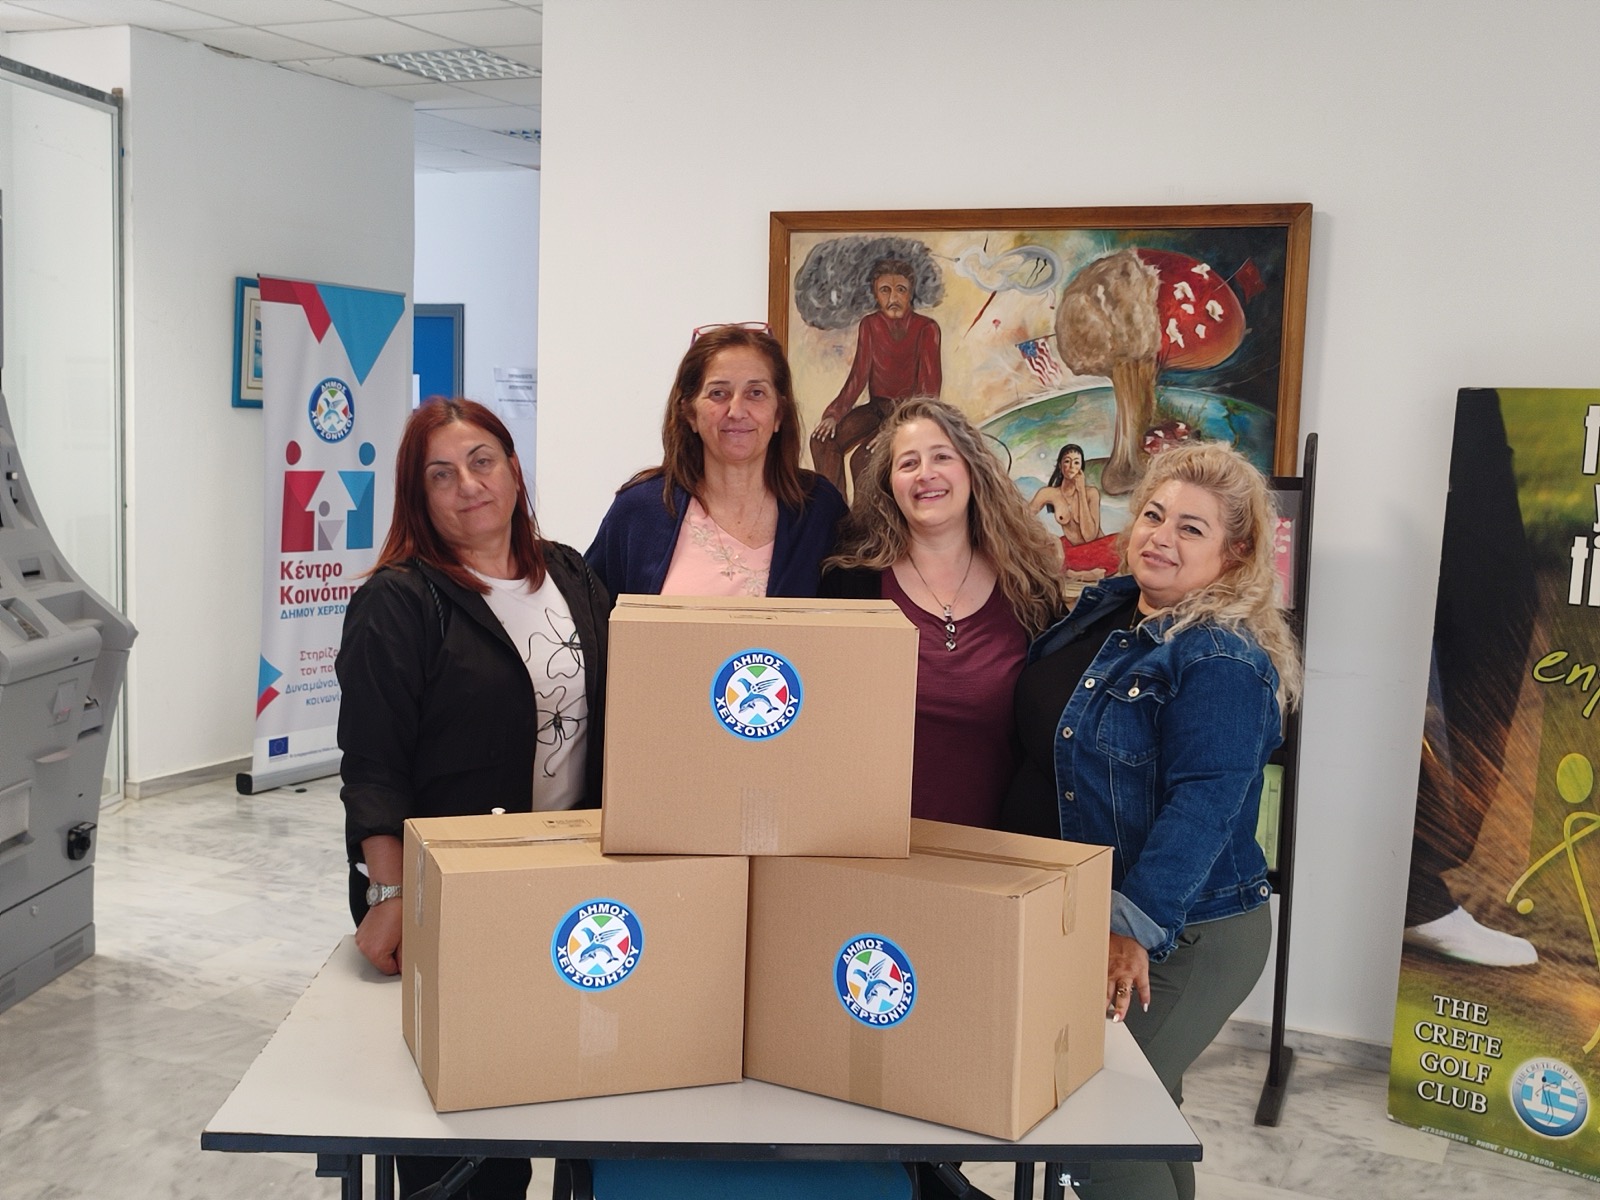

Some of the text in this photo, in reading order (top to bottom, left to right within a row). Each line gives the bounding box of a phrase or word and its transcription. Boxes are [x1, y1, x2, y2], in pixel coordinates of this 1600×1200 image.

[321, 381, 347, 393] ΔΗΜΟΣ
[280, 560, 343, 582] Κέντρο
[280, 582, 362, 605] Κοινότητ
[280, 604, 348, 619] ΔΗΜΟΥ ΧΕΡΣΟ
[301, 665, 334, 676] τον πο
[732, 654, 784, 670] ΔΗΜΟΣ
[715, 694, 799, 736] ΧΕΡΣΟΝΗΣΟΥ
[579, 903, 629, 921] ΔΗΜΟΣ
[842, 939, 884, 964] ΔΗΜΟΣ
[557, 945, 640, 987] ΧΕΡΣΟΝΗΣΟΥ
[842, 970, 913, 1024] ΧΕΡΣΟΝΗΣΟΥ
[1433, 995, 1489, 1025] THE
[1414, 1021, 1502, 1058] CRETE
[1420, 1052, 1491, 1084] GOLF
[1417, 1080, 1488, 1114] CLUB
